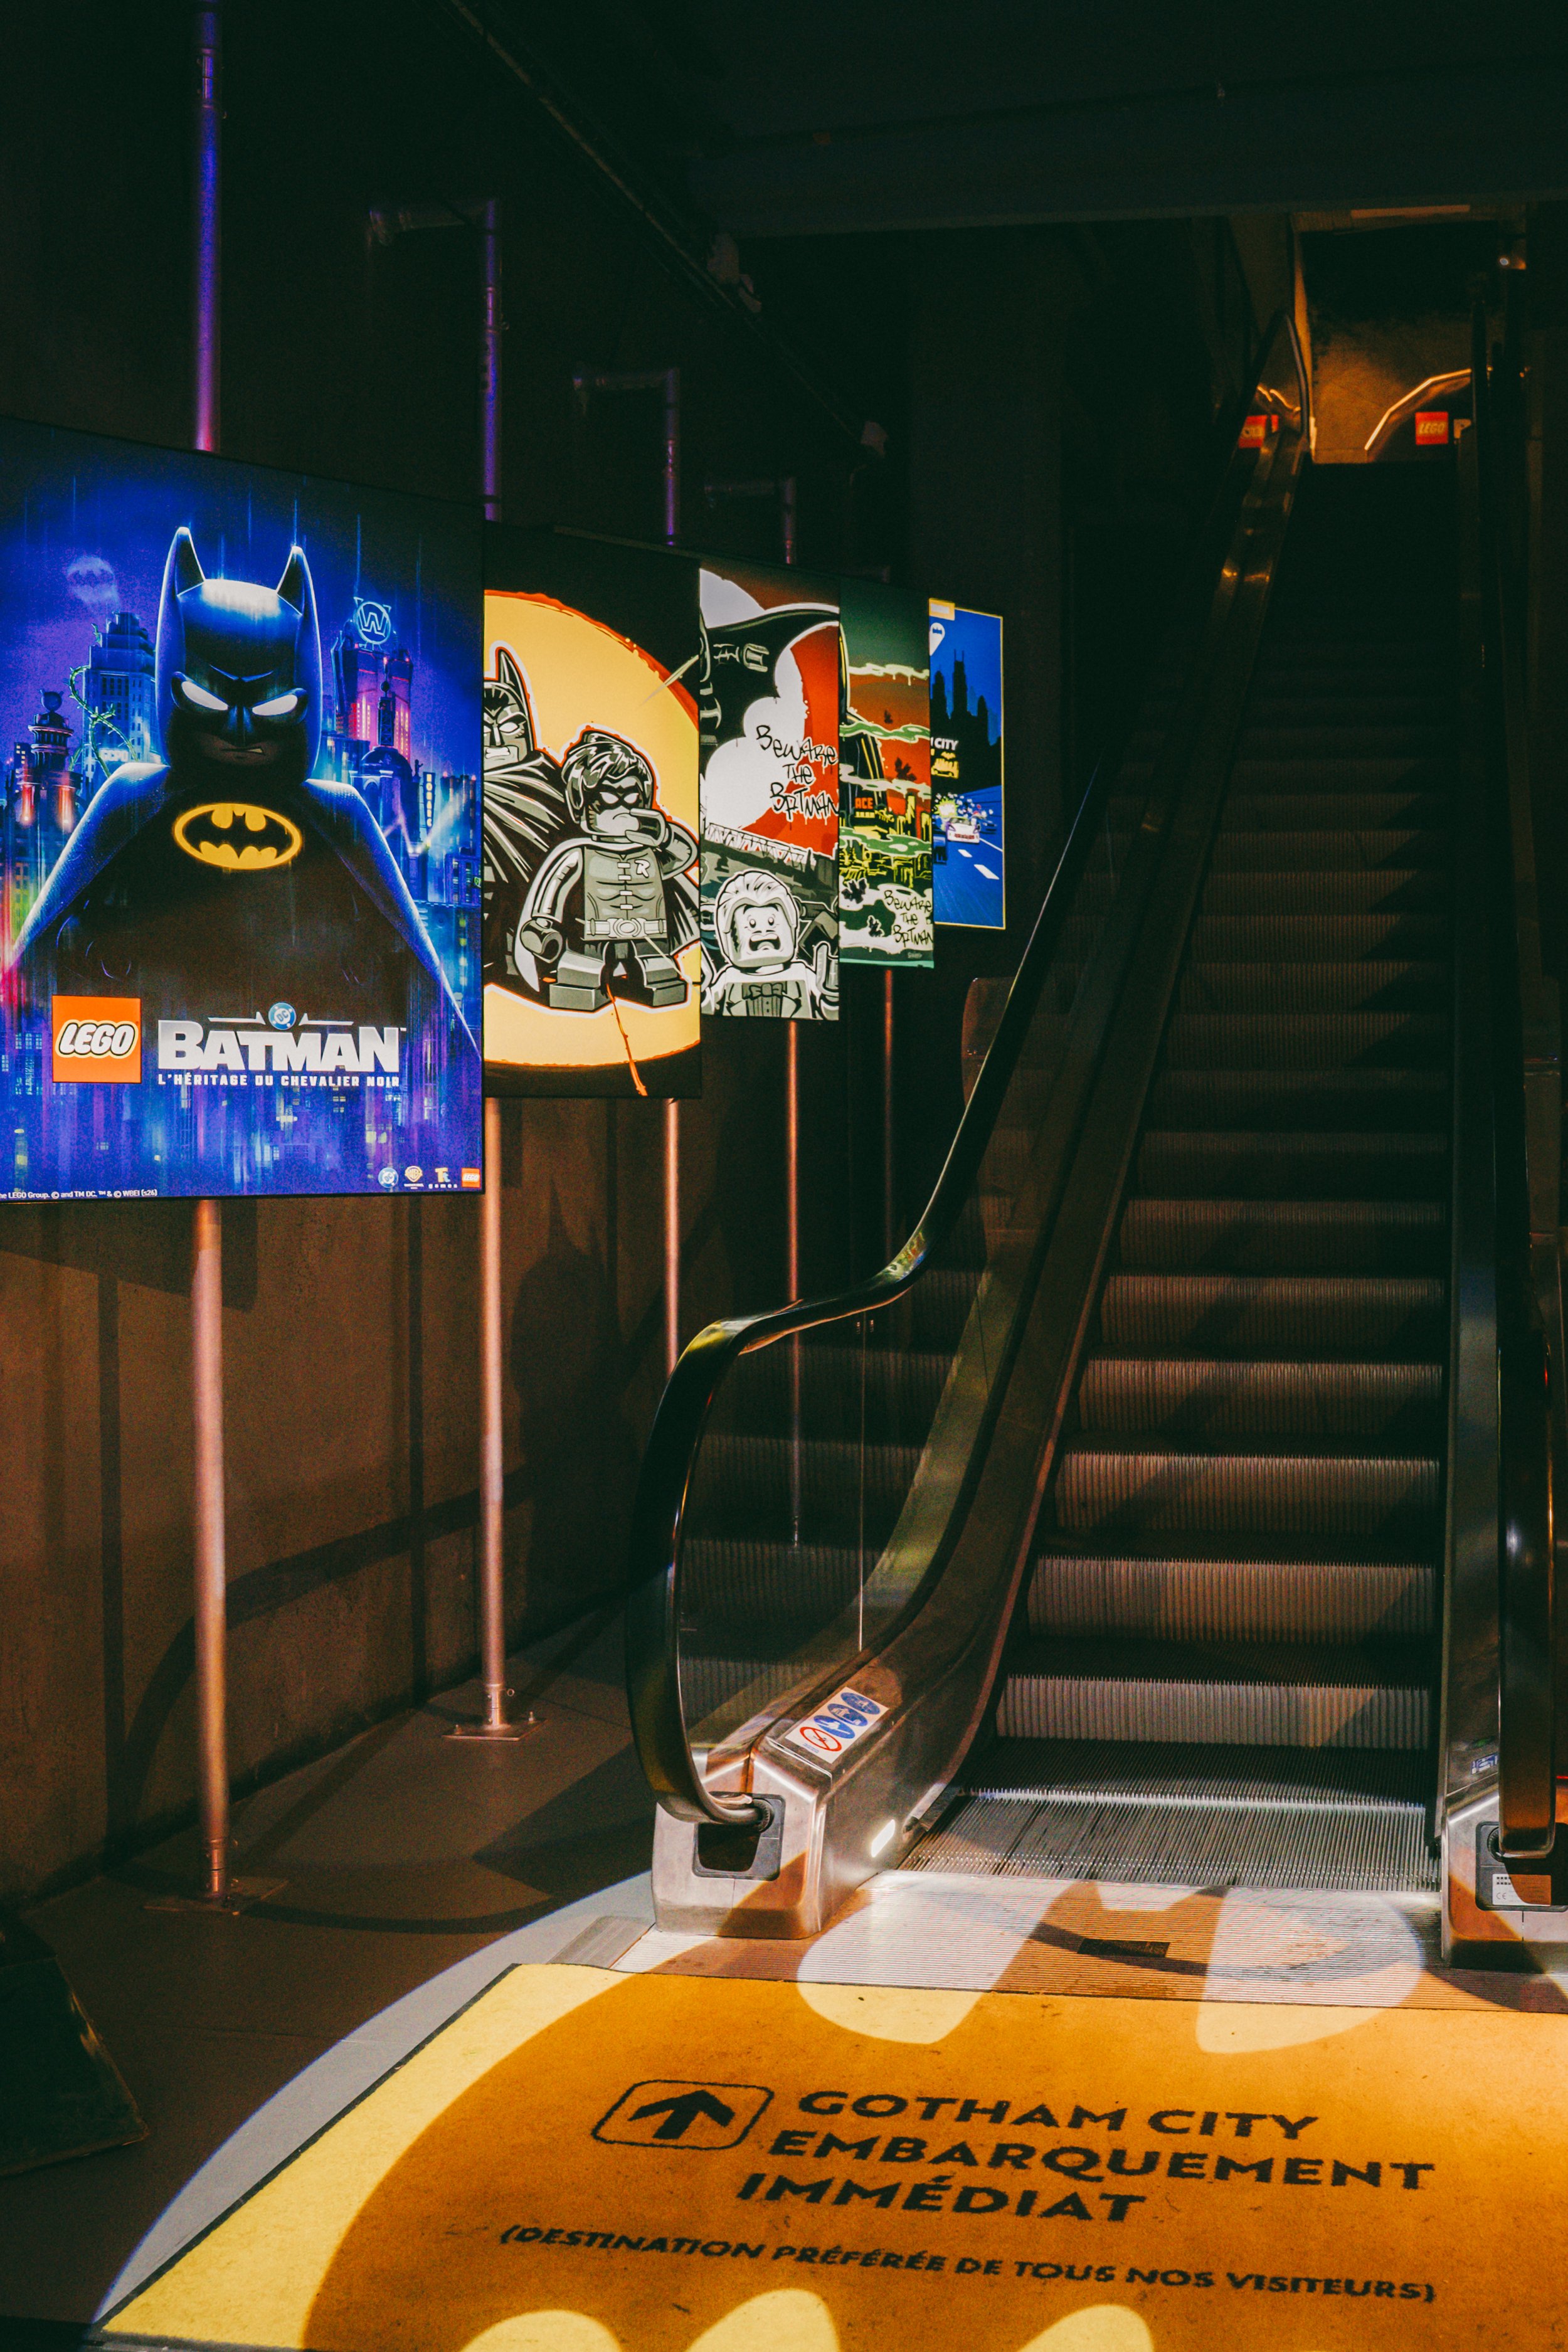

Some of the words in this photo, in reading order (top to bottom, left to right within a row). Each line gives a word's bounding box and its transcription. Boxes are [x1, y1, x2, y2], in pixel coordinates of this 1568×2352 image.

[1418, 421, 1446, 435] LEGO
[934, 737, 959, 751] CITY
[855, 797, 873, 809] ACE
[634, 859, 650, 878] R
[57, 1021, 137, 1057] LEGO
[158, 1020, 400, 1073] BATMAN
[158, 1073, 248, 1086] L'HÉRITAGE
[255, 1075, 274, 1086] DU
[281, 1076, 360, 1087] CHEVALIER
[367, 1076, 400, 1087] NOIR
[798, 2090, 1126, 2131] GOTHAM
[1148, 2109, 1318, 2139] CITY
[768, 2130, 1434, 2190] EMBARQUEMENT
[736, 2173, 1147, 2222] IMMÉDIAT
[500, 2224, 766, 2259] (DESTINATION
[771, 2245, 947, 2272] PRÉFÉRÉE
[955, 2257, 1003, 2275] DE
[1014, 2261, 1116, 2282] TOUS
[1125, 2267, 1215, 2288] NOS
[1227, 2272, 1436, 2304] VISITEURS)
